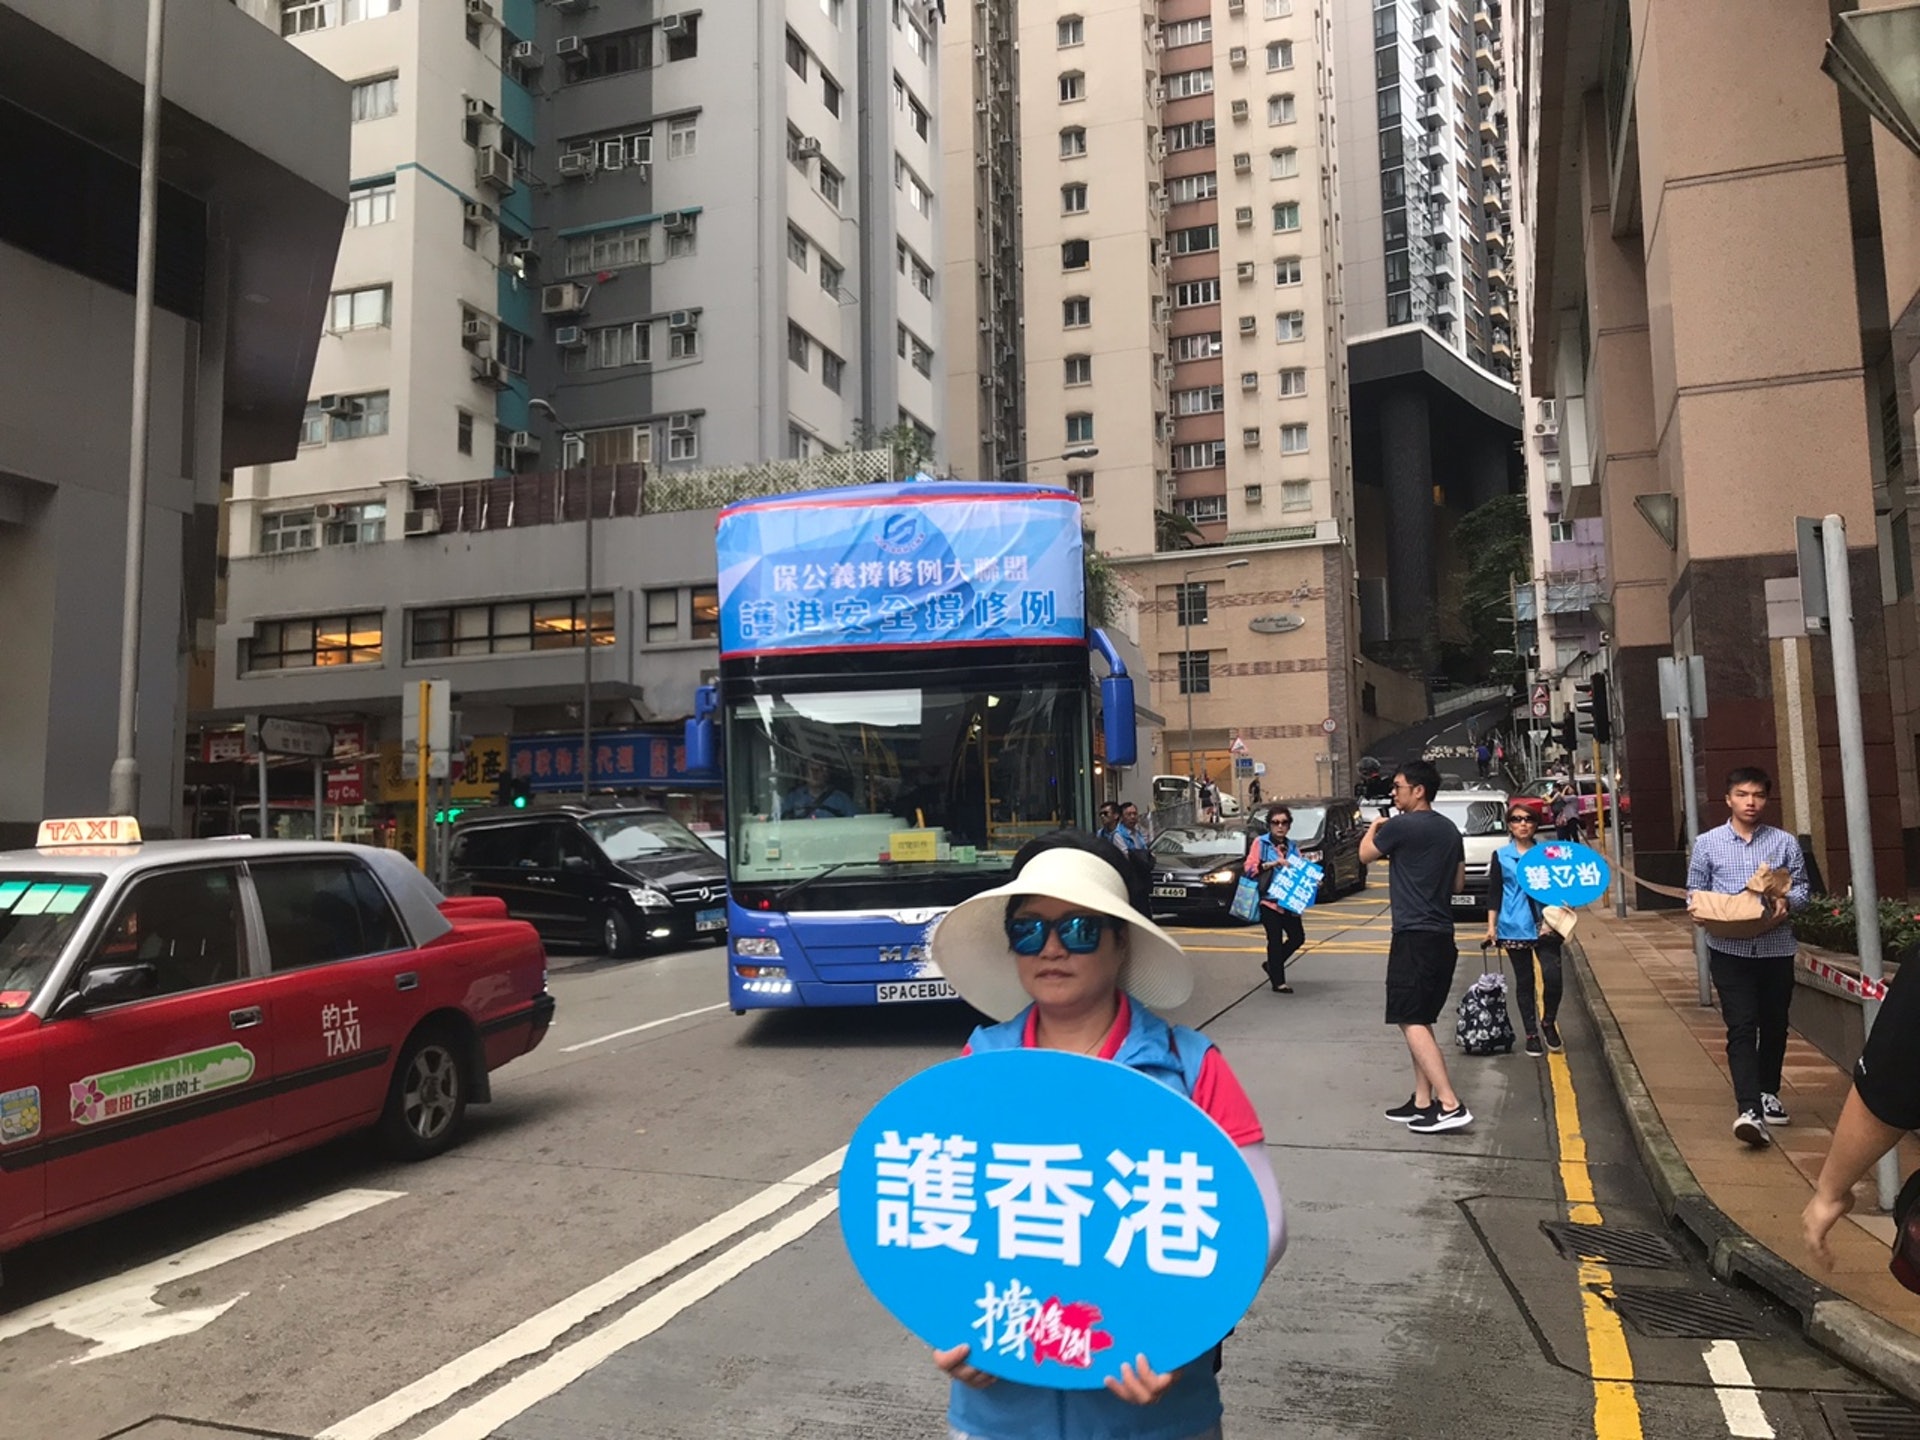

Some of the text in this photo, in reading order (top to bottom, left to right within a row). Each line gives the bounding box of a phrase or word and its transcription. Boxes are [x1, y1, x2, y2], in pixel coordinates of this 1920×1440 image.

[773, 555, 1028, 592] 保公義撐修例大聯盟
[739, 589, 1057, 639] 護港安全撐修例
[342, 785, 360, 798] Co.
[46, 820, 118, 841] TAXI
[1524, 861, 1601, 890] 保公義
[1162, 888, 1185, 896] 4469
[878, 945, 931, 962] MA
[879, 983, 956, 1000] SPACEBUS
[321, 999, 359, 1029] 的士
[323, 1024, 361, 1057] TAXI
[104, 1077, 202, 1116] 豐田石油氣的士
[874, 1130, 1221, 1278] 護香港
